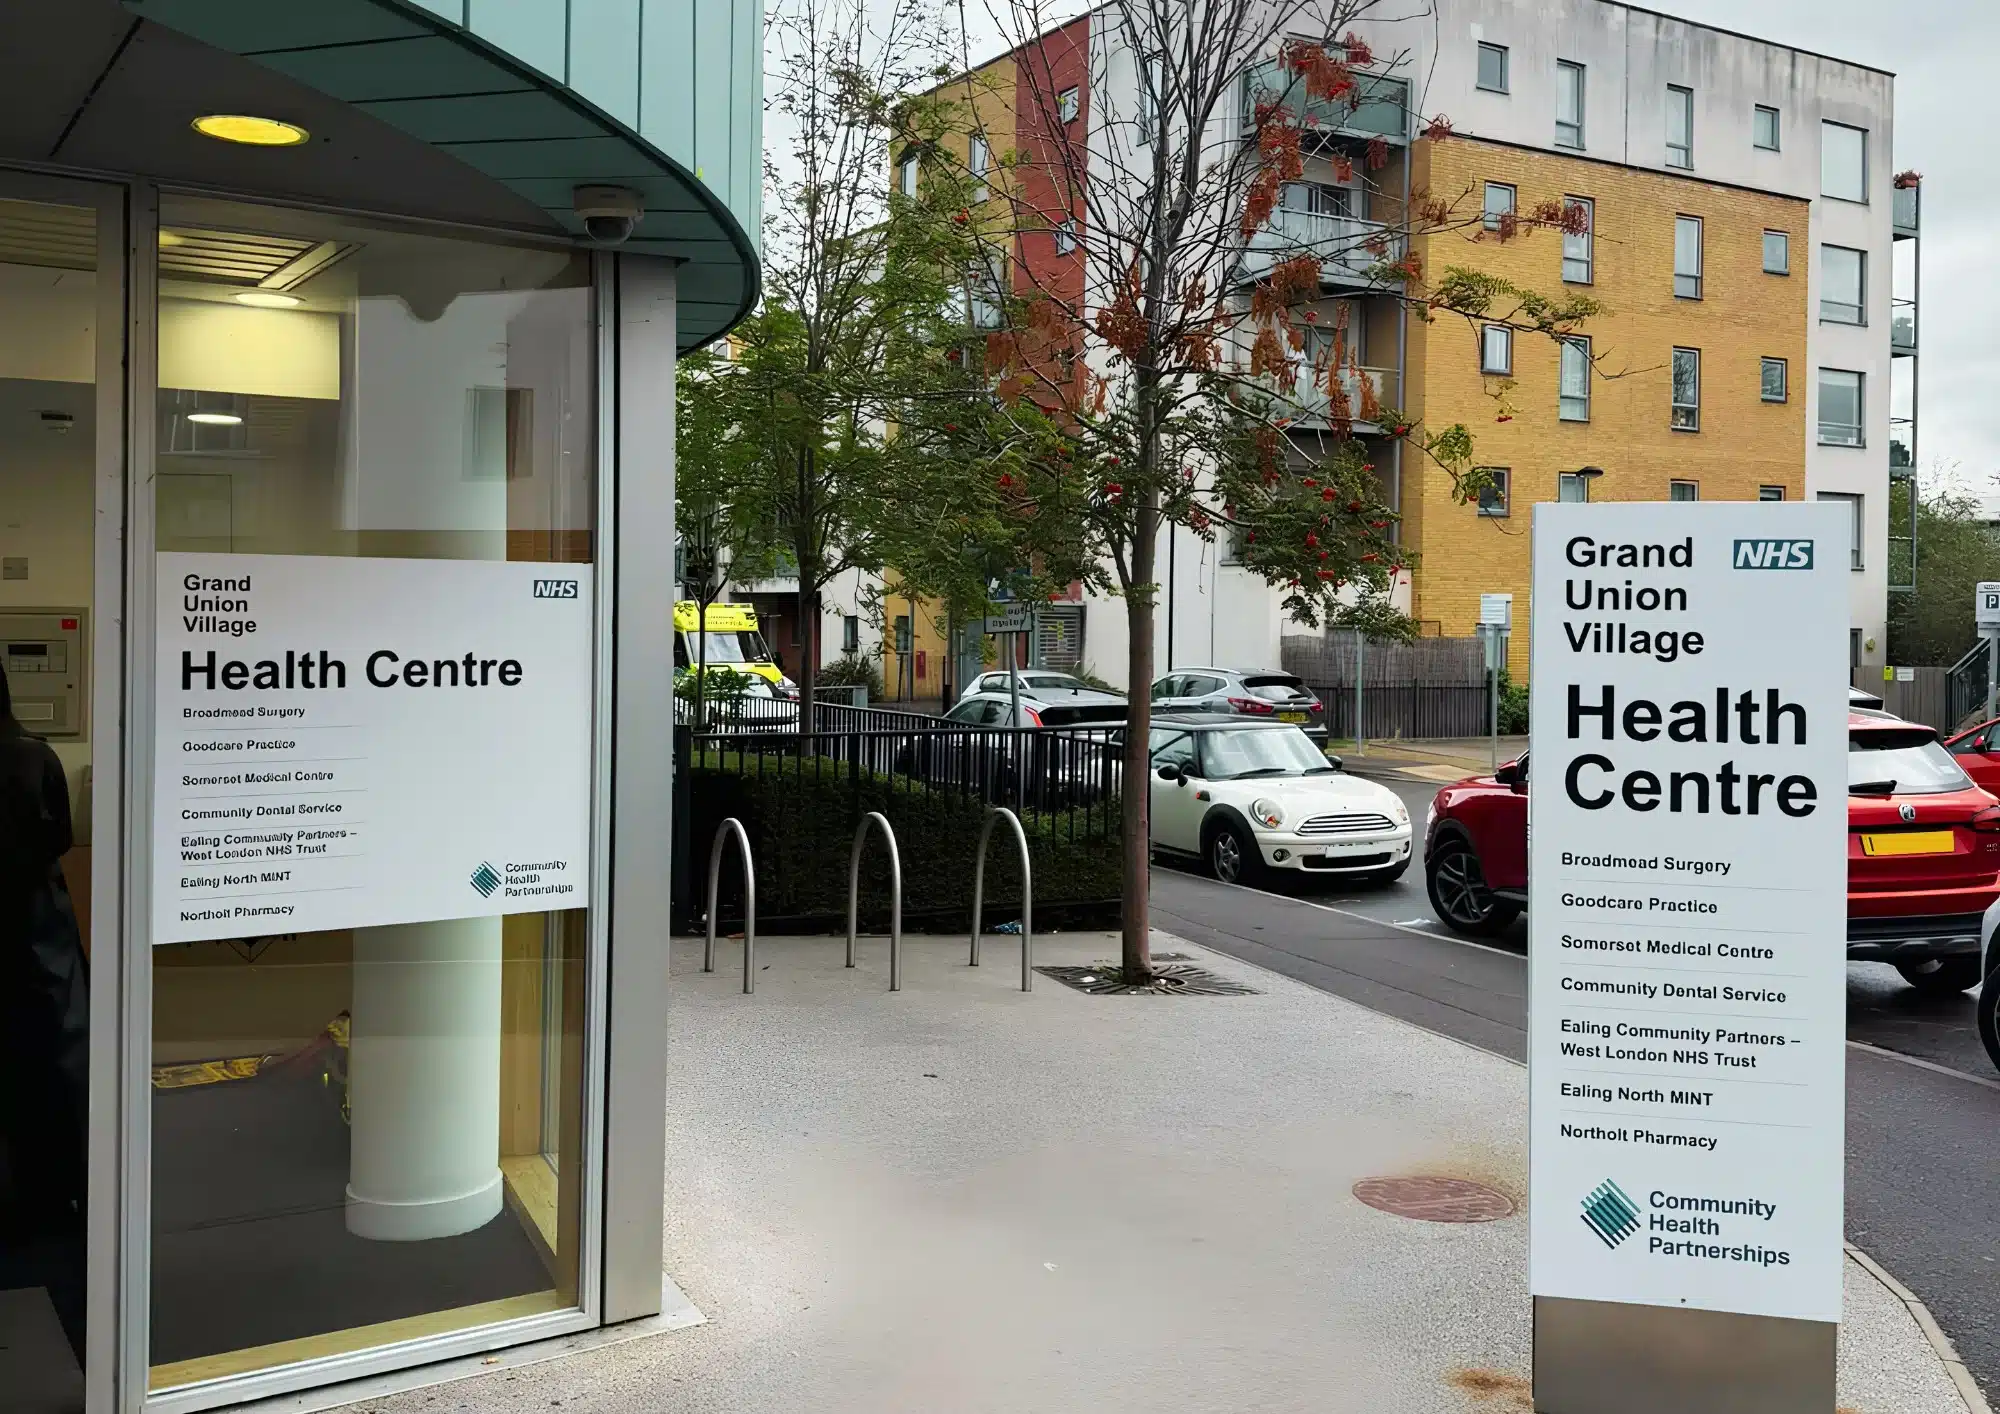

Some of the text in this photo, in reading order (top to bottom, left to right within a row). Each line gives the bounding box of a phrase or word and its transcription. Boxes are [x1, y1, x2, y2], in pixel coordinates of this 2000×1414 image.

[1565, 536, 1693, 568] Grand
[1735, 541, 1811, 568] NHS
[184, 574, 251, 592] Grand
[535, 581, 577, 598] NHS
[1565, 579, 1687, 611] Union
[184, 595, 248, 613] Union
[1988, 595, 1997, 608] P
[183, 616, 257, 637] Village
[1563, 621, 1705, 663] Village
[181, 650, 523, 691] Health Centre
[1567, 683, 1807, 746] Health
[1564, 753, 1818, 818] Centre
[266, 844, 293, 856] NHS
[1646, 939, 1712, 956] Medical
[1560, 977, 1787, 1003] Community Dental Service
[1560, 1018, 1611, 1038] Ealing
[1616, 1022, 1711, 1045] Community
[1715, 1028, 1786, 1046] Partners
[1560, 1042, 1757, 1068] West London NHS Trust
[1560, 1082, 1714, 1106] Ealing North MINT
[1560, 1123, 1718, 1152] Northolt Pharmacy
[1649, 1190, 1777, 1221] Community
[1649, 1213, 1720, 1237] Health
[1649, 1236, 1790, 1268] Partnerships
